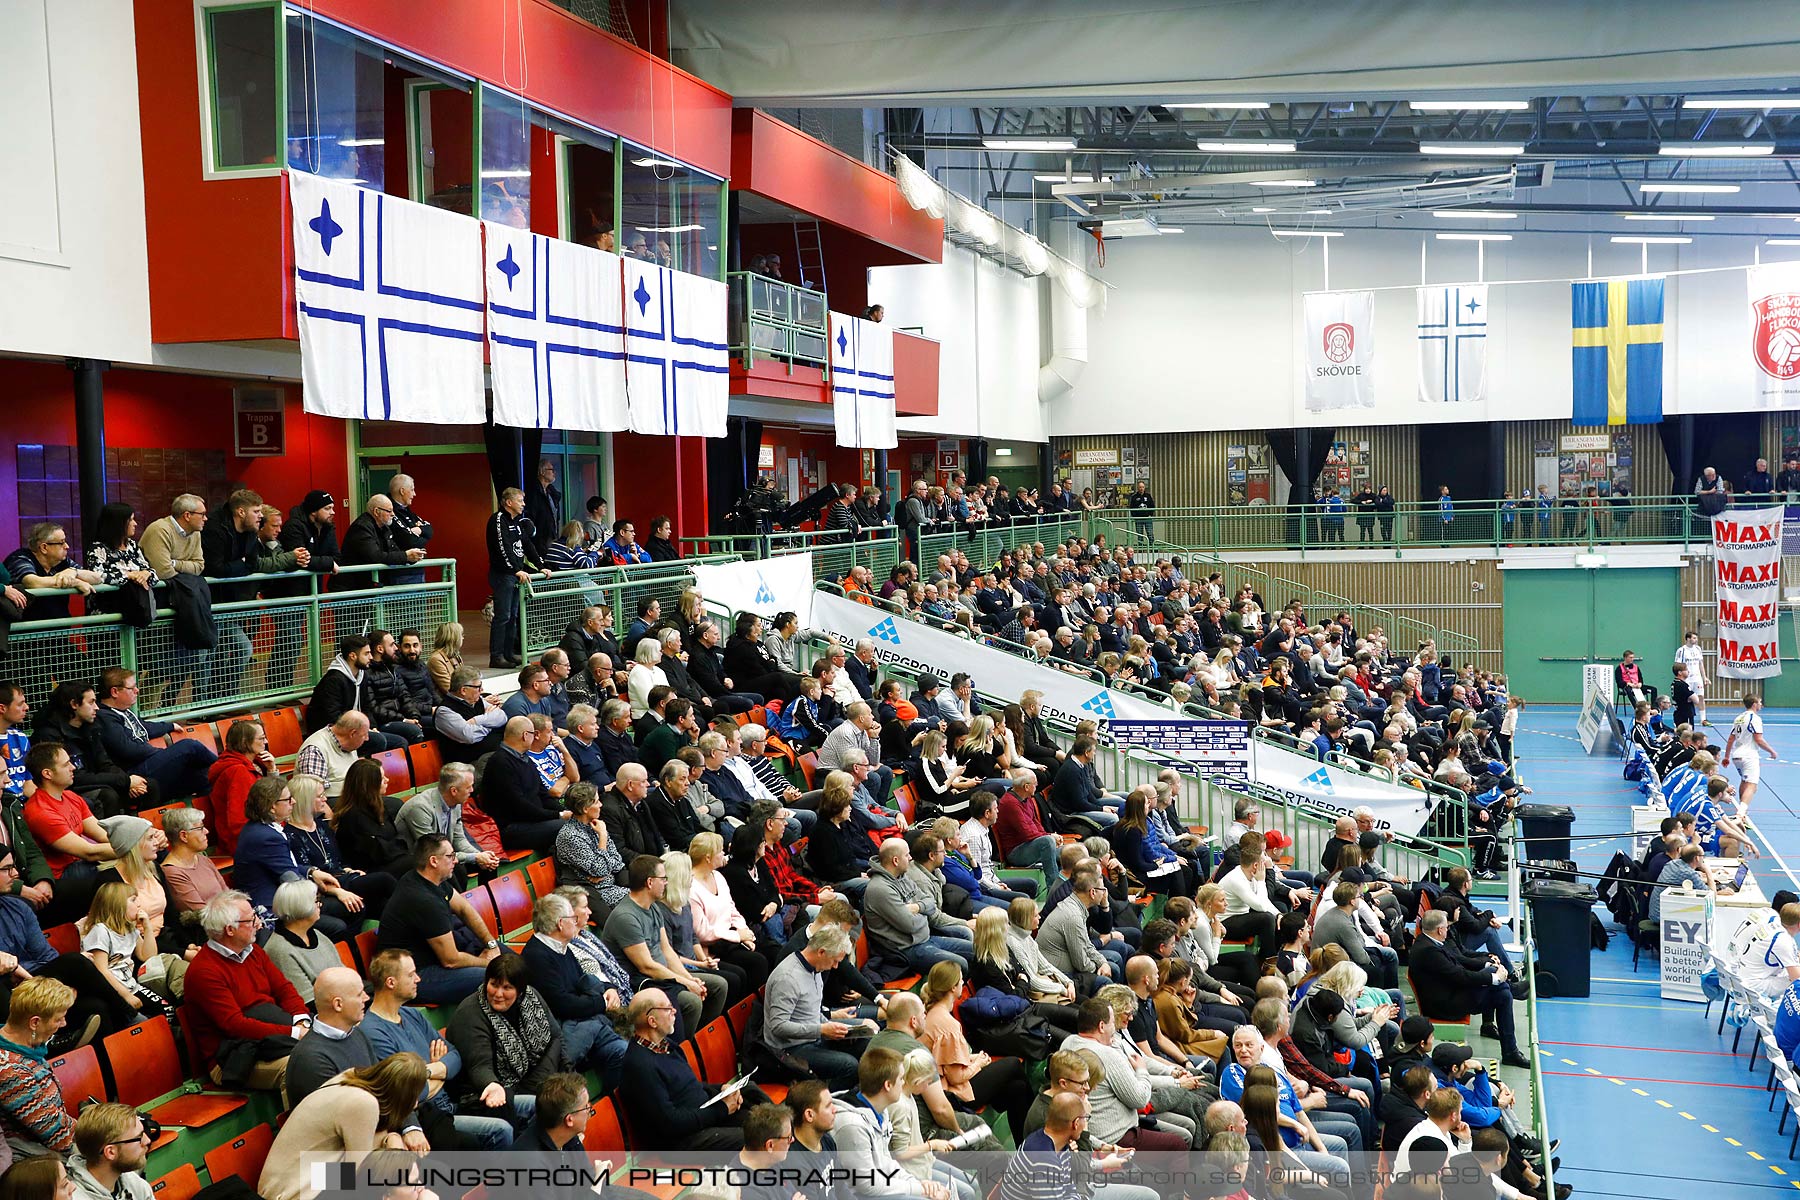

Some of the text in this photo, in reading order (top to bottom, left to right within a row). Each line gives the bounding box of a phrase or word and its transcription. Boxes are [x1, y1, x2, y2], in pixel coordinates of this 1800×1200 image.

[1316, 364, 1362, 377] SKÖVDE
[247, 413, 274, 423] Trappa
[252, 423, 268, 445] B
[945, 455, 953, 465] D
[1715, 520, 1781, 544] MAXI
[1718, 559, 1779, 583] MAXI
[1719, 598, 1777, 623] MAXI
[1719, 637, 1777, 662] MAXI
[1663, 919, 1702, 945] EY
[1664, 945, 1703, 959] Building
[1664, 956, 1702, 967] a better
[1664, 965, 1703, 976] working
[1664, 974, 1691, 984] world
